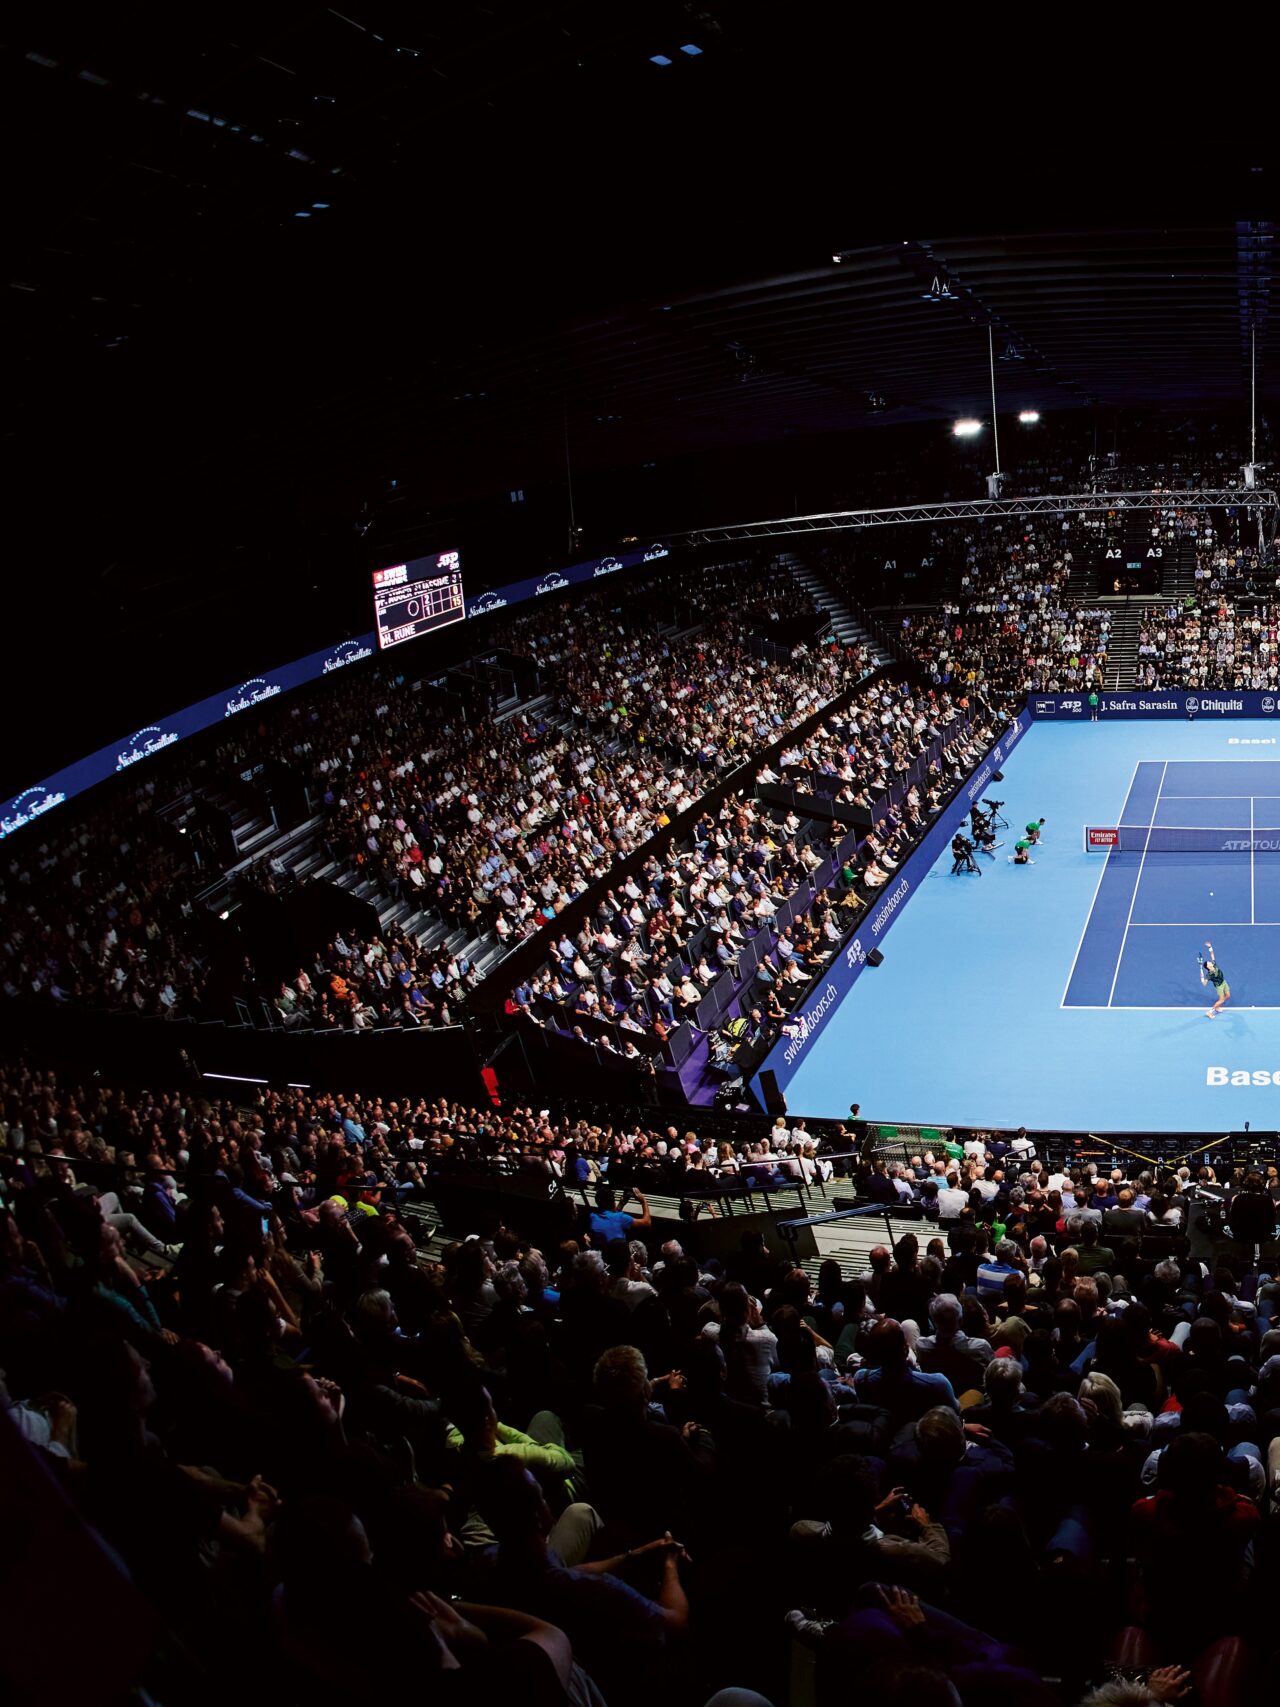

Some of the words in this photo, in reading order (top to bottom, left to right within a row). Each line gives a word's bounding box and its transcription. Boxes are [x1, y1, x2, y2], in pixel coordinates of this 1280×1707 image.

[1105, 549, 1122, 559] A2
[1146, 548, 1163, 558] A3
[884, 560, 897, 570] A1
[425, 595, 430, 604] 2
[452, 597, 461, 606] 15
[394, 624, 416, 641] RUNE
[322, 658, 345, 674] Nicolas
[237, 678, 266, 694] CHAMPAGNE
[225, 697, 250, 717] Nicolas
[1060, 701, 1082, 709] ATP
[1101, 701, 1108, 712] J.
[1109, 700, 1137, 710] Safra
[1139, 700, 1178, 710] Sarasin
[1201, 699, 1243, 714] Chiquita
[1221, 840, 1251, 850] ATP
[871, 878, 910, 936] swissindoors.ch
[847, 938, 861, 968] ATP
